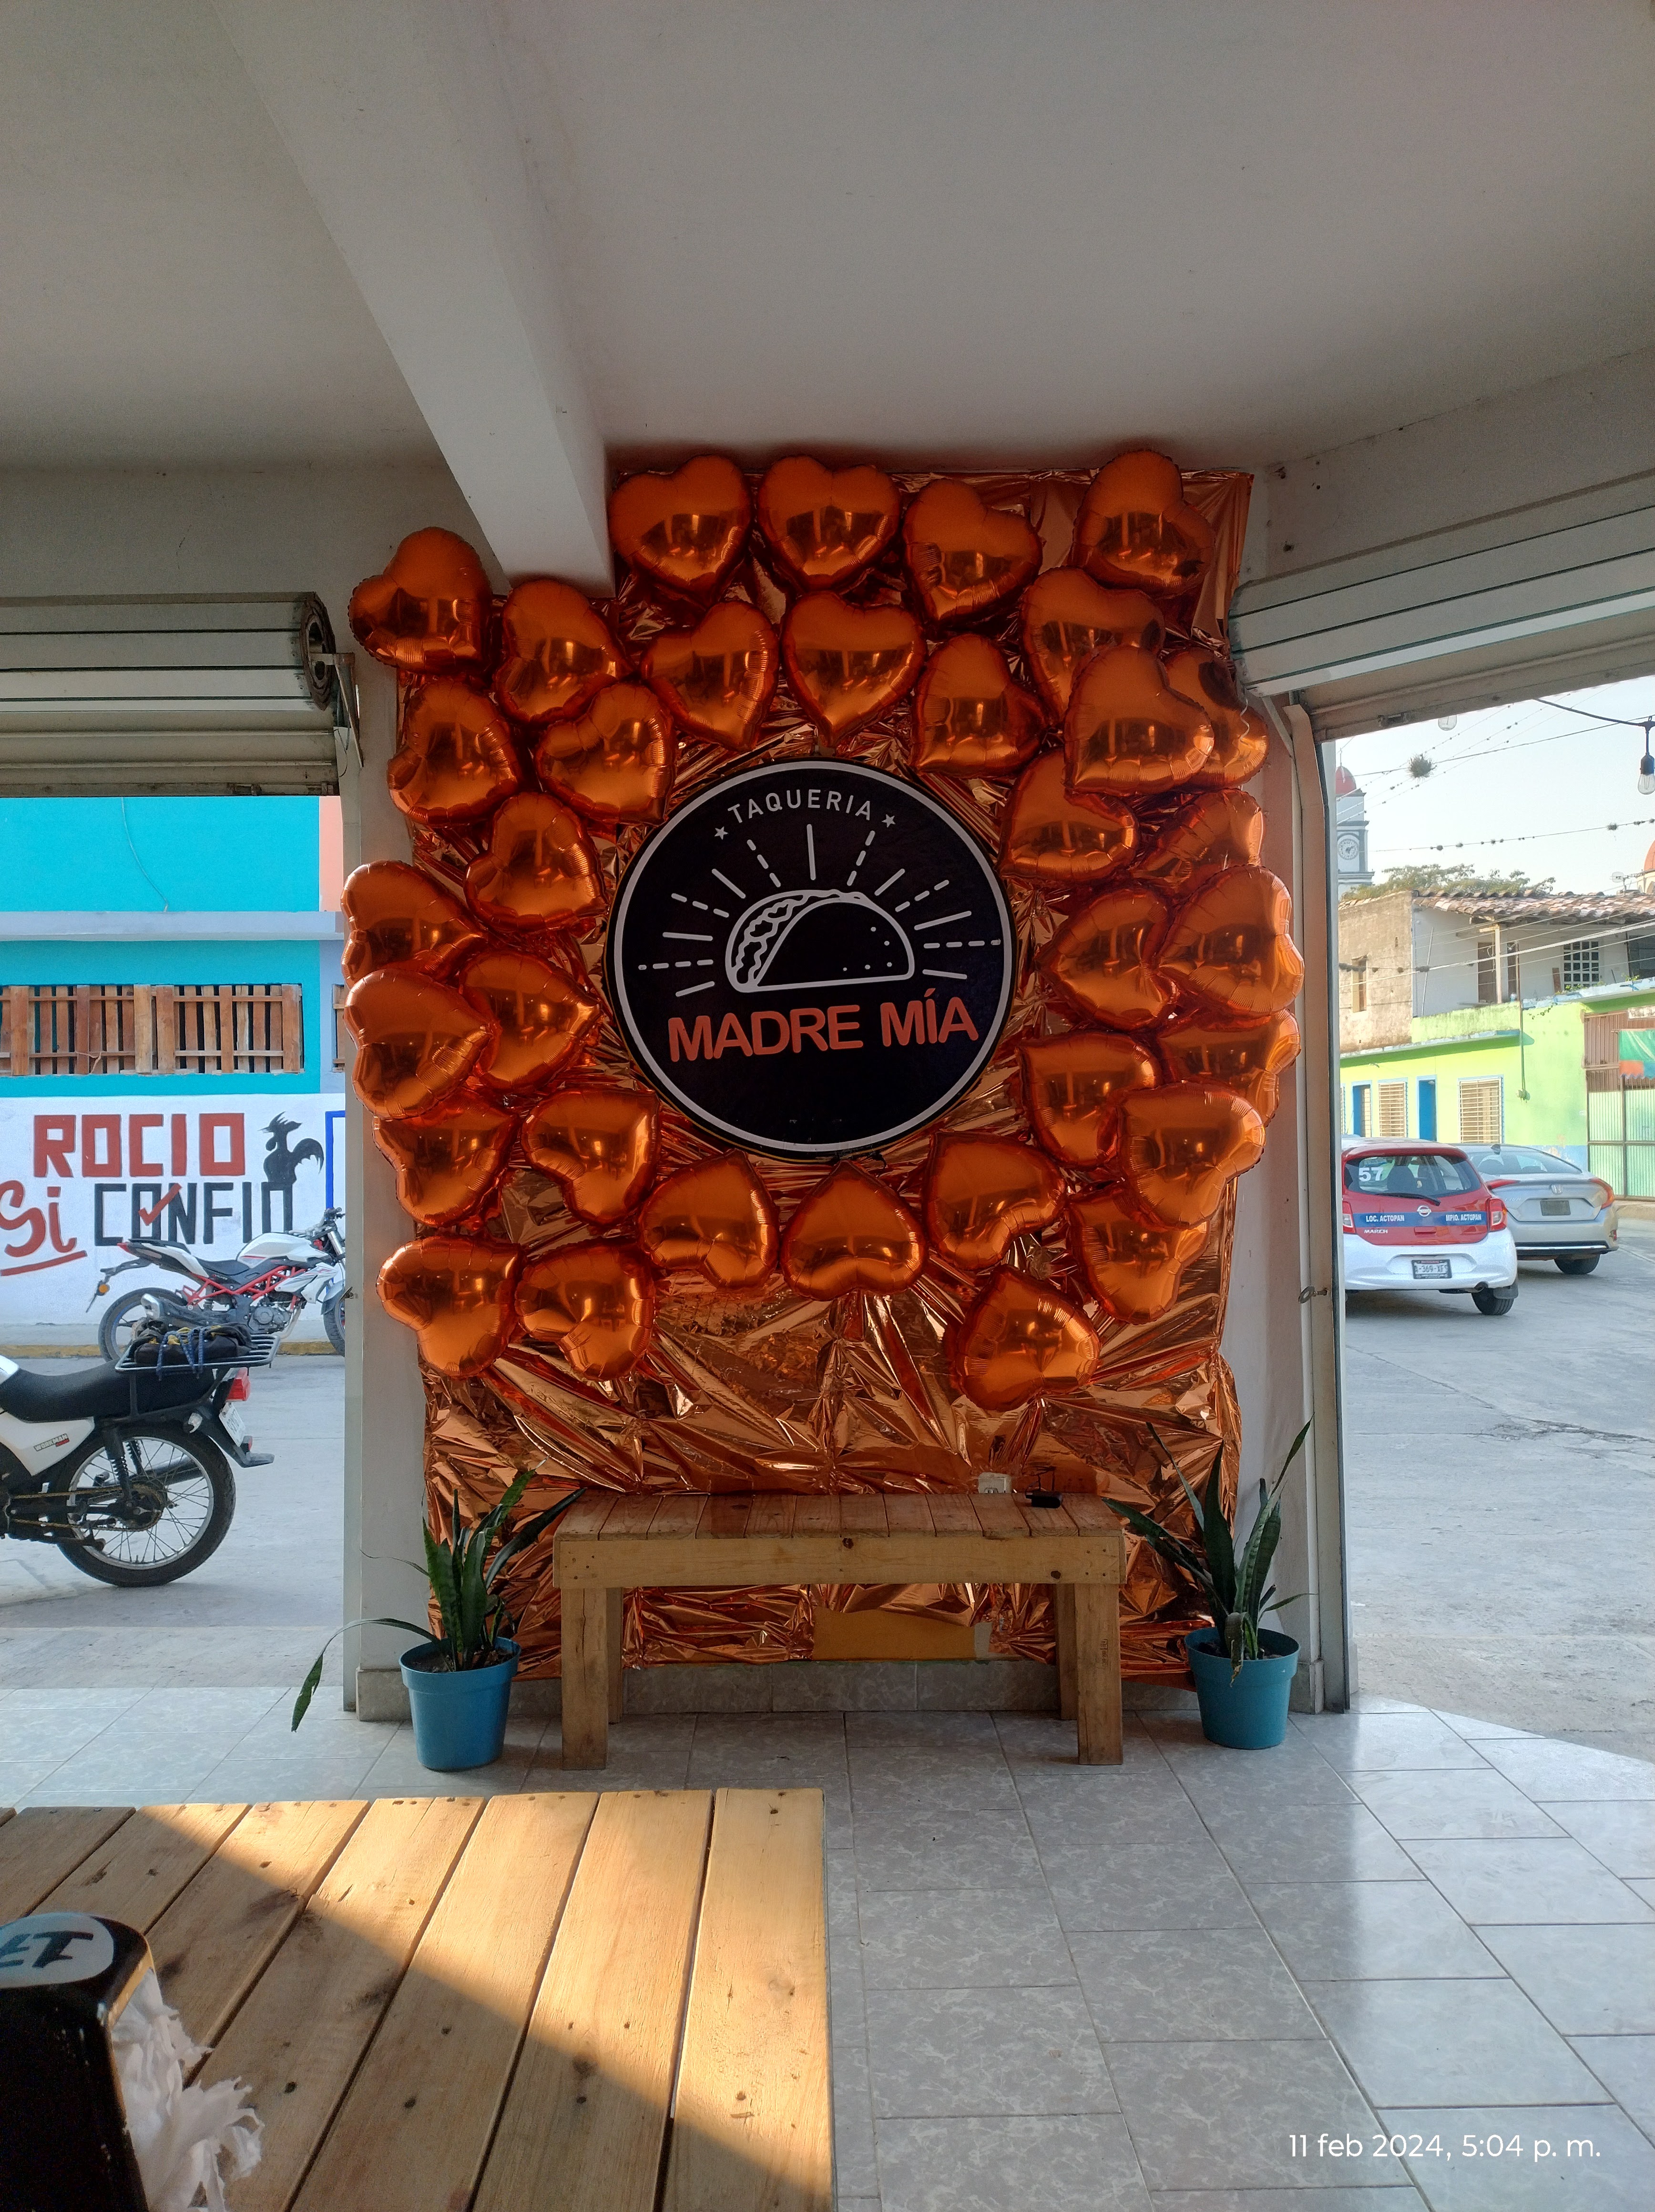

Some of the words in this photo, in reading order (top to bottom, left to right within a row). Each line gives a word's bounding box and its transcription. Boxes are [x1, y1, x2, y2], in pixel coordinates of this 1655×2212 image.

[728, 789, 872, 823] TAQUERIA
[668, 1004, 864, 1062] MADRE
[880, 988, 979, 1047] MÍA
[34, 1113, 245, 1178] ROCIO
[1359, 1167, 1383, 1181] 57
[0, 1180, 77, 1258] Si
[94, 1182, 294, 1246] CONFIO
[34, 1434, 68, 1451] WORKMAN
